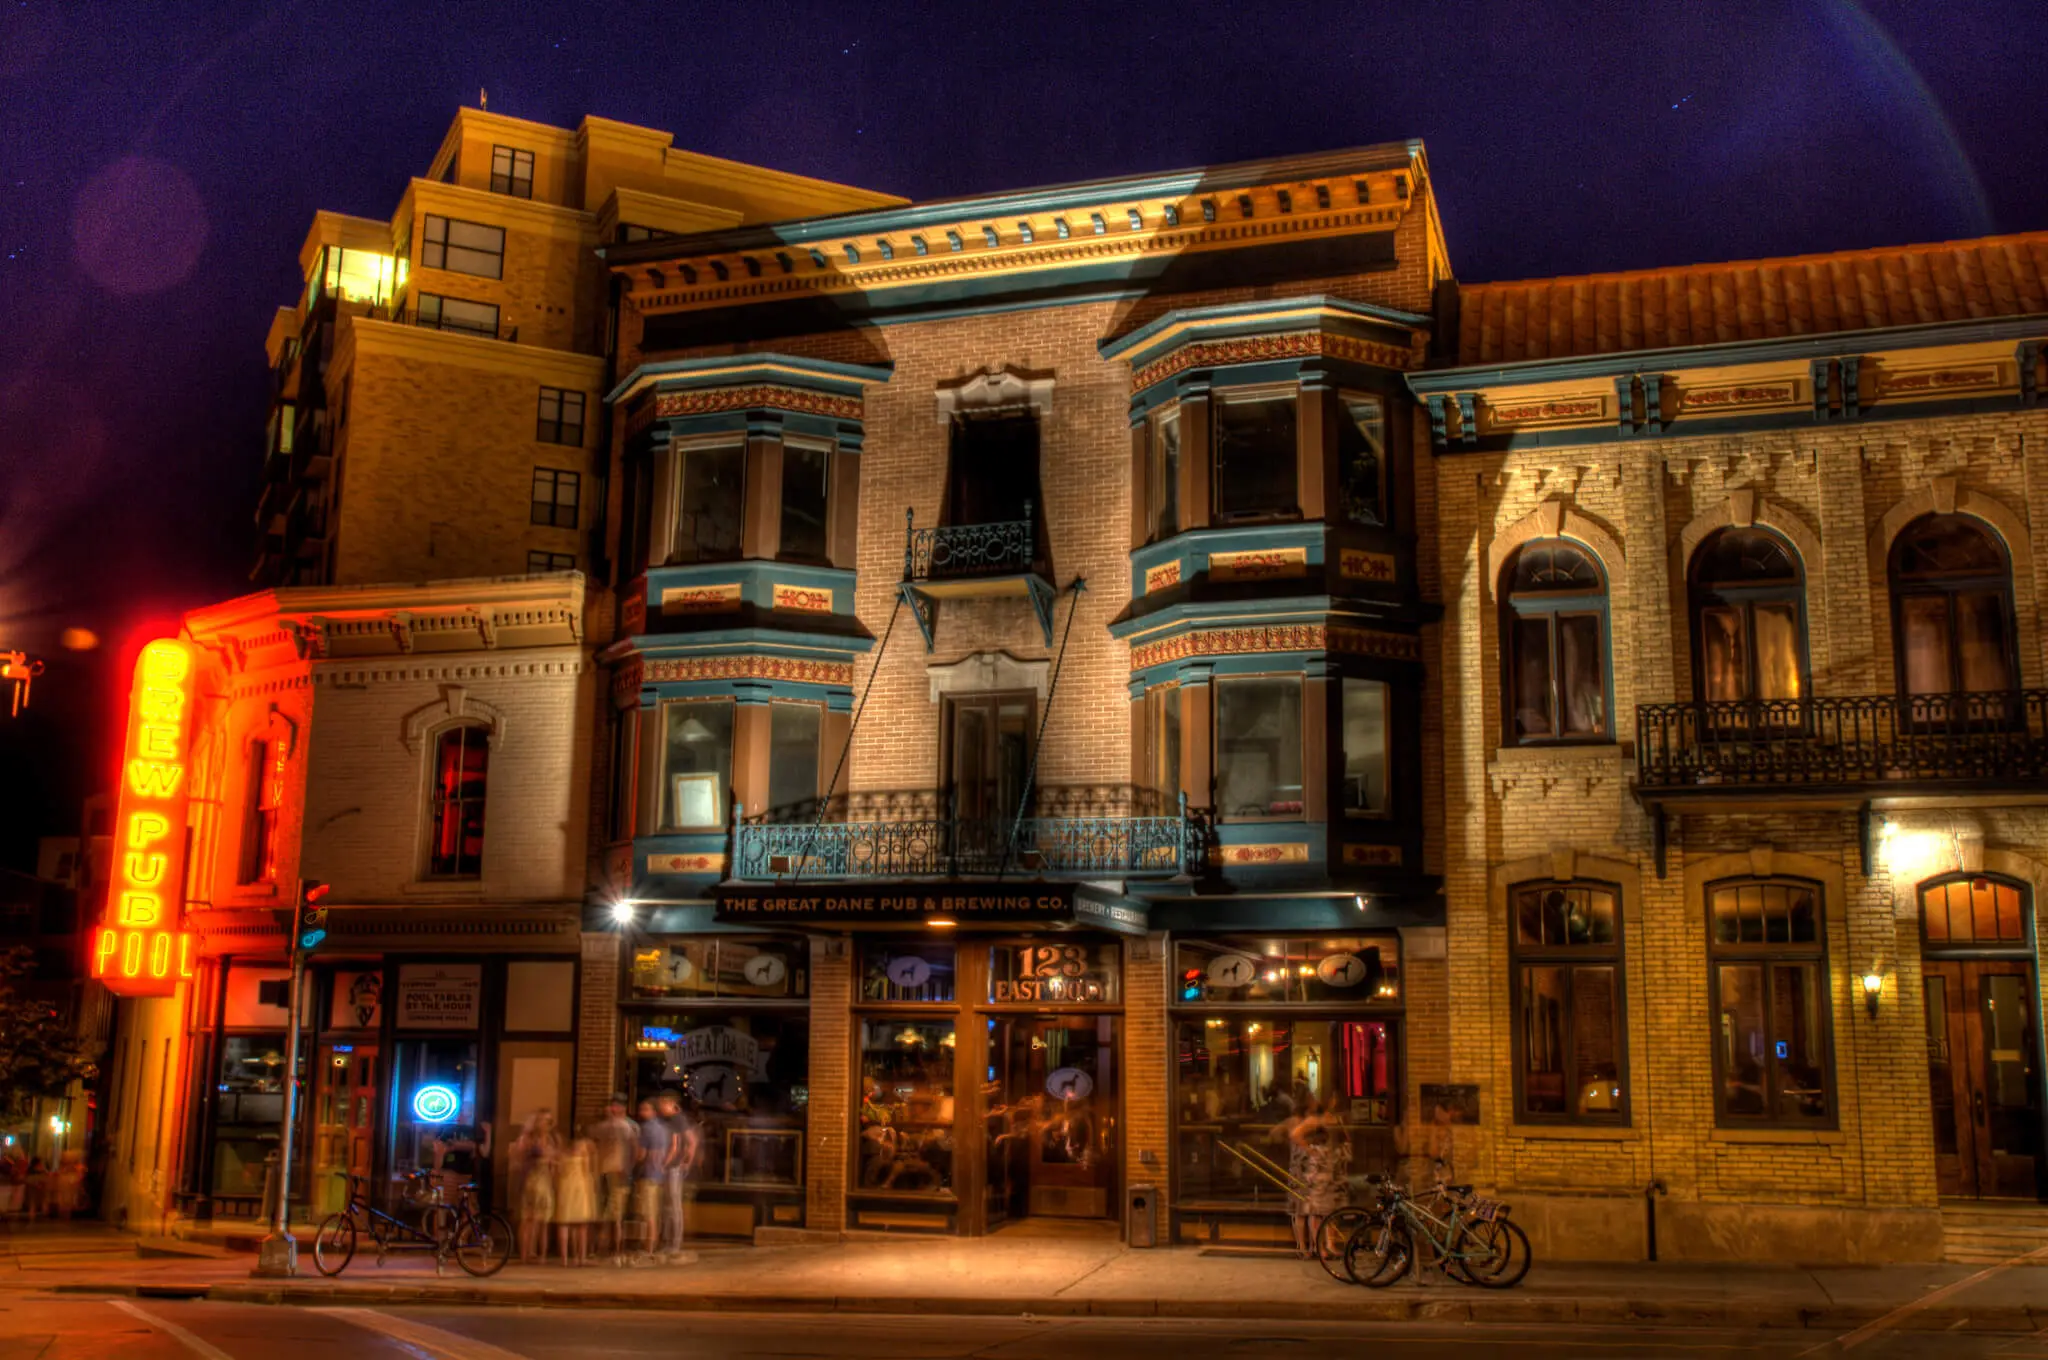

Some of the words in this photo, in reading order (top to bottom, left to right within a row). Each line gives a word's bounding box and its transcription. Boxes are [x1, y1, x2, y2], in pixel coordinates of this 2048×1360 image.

[126, 643, 188, 798] BREW
[118, 811, 169, 928] PUB
[723, 898, 757, 911] THE
[763, 898, 821, 911] GREAT
[826, 898, 874, 911] DANE
[880, 897, 918, 911] PUB
[924, 897, 936, 910] &
[942, 897, 1031, 910] BREWING
[1037, 897, 1067, 910] CO.
[98, 929, 193, 978] POOL
[1019, 946, 1087, 977] 123
[406, 993, 431, 1002] POOL
[434, 993, 472, 1002] TABLES
[995, 980, 1044, 1000] EAST
[406, 1003, 418, 1011] BY
[422, 1003, 441, 1011] THE
[443, 1003, 471, 1011] HOUR
